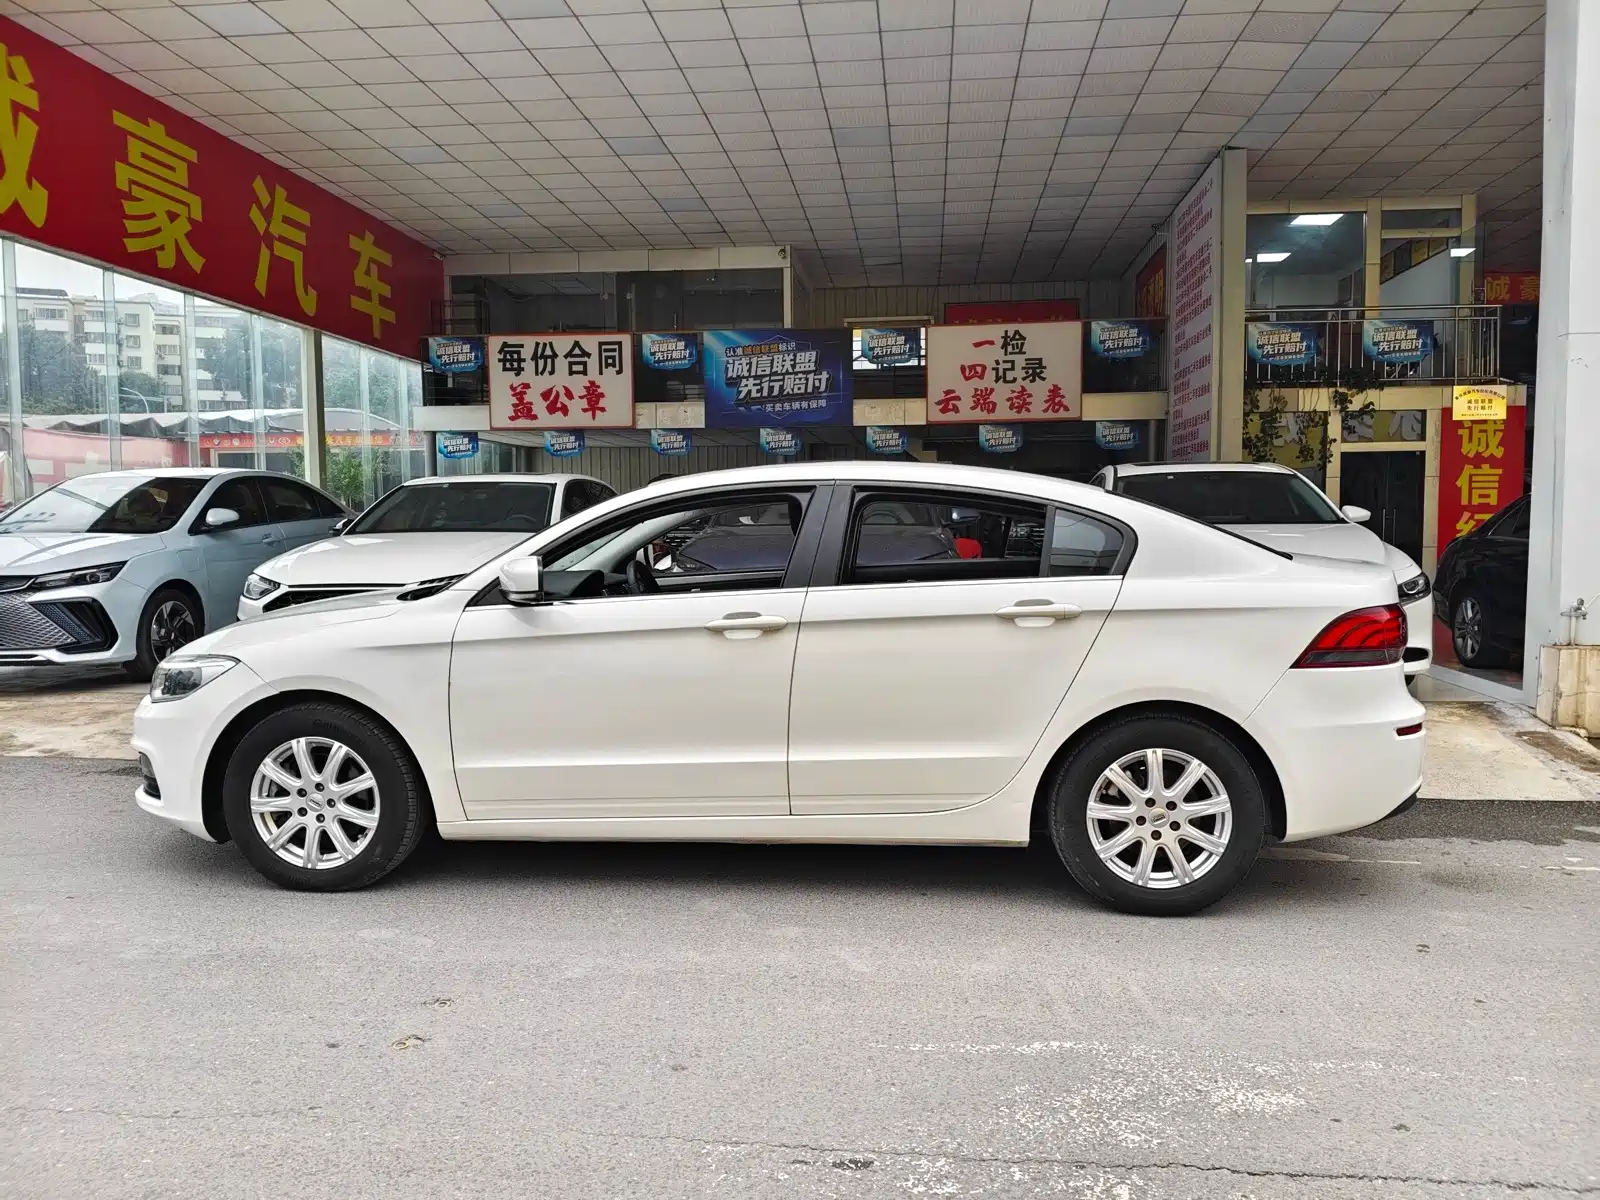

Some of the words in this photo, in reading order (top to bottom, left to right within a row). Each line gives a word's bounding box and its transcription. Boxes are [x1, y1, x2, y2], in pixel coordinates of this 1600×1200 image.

[869, 336, 905, 347] 诚信联盟
[1258, 332, 1302, 345] 诚信联盟
[1373, 330, 1418, 342] 诚信联盟
[972, 330, 1027, 356] 一检
[1104, 337, 1143, 349] 先行赔付
[1262, 342, 1307, 355] 先行赔付
[1378, 338, 1424, 352] 先行赔付
[655, 349, 690, 361] 先行赔付
[874, 344, 910, 356] 先行赔付
[497, 340, 623, 377] 每份合同
[727, 351, 817, 378] 诚信联盟
[960, 358, 1047, 384] 四记录
[738, 370, 829, 400] 先行赔付
[508, 380, 607, 422] 盖公章
[765, 399, 827, 412] 买卖车辆有保障
[934, 384, 1070, 416] 云端读表
